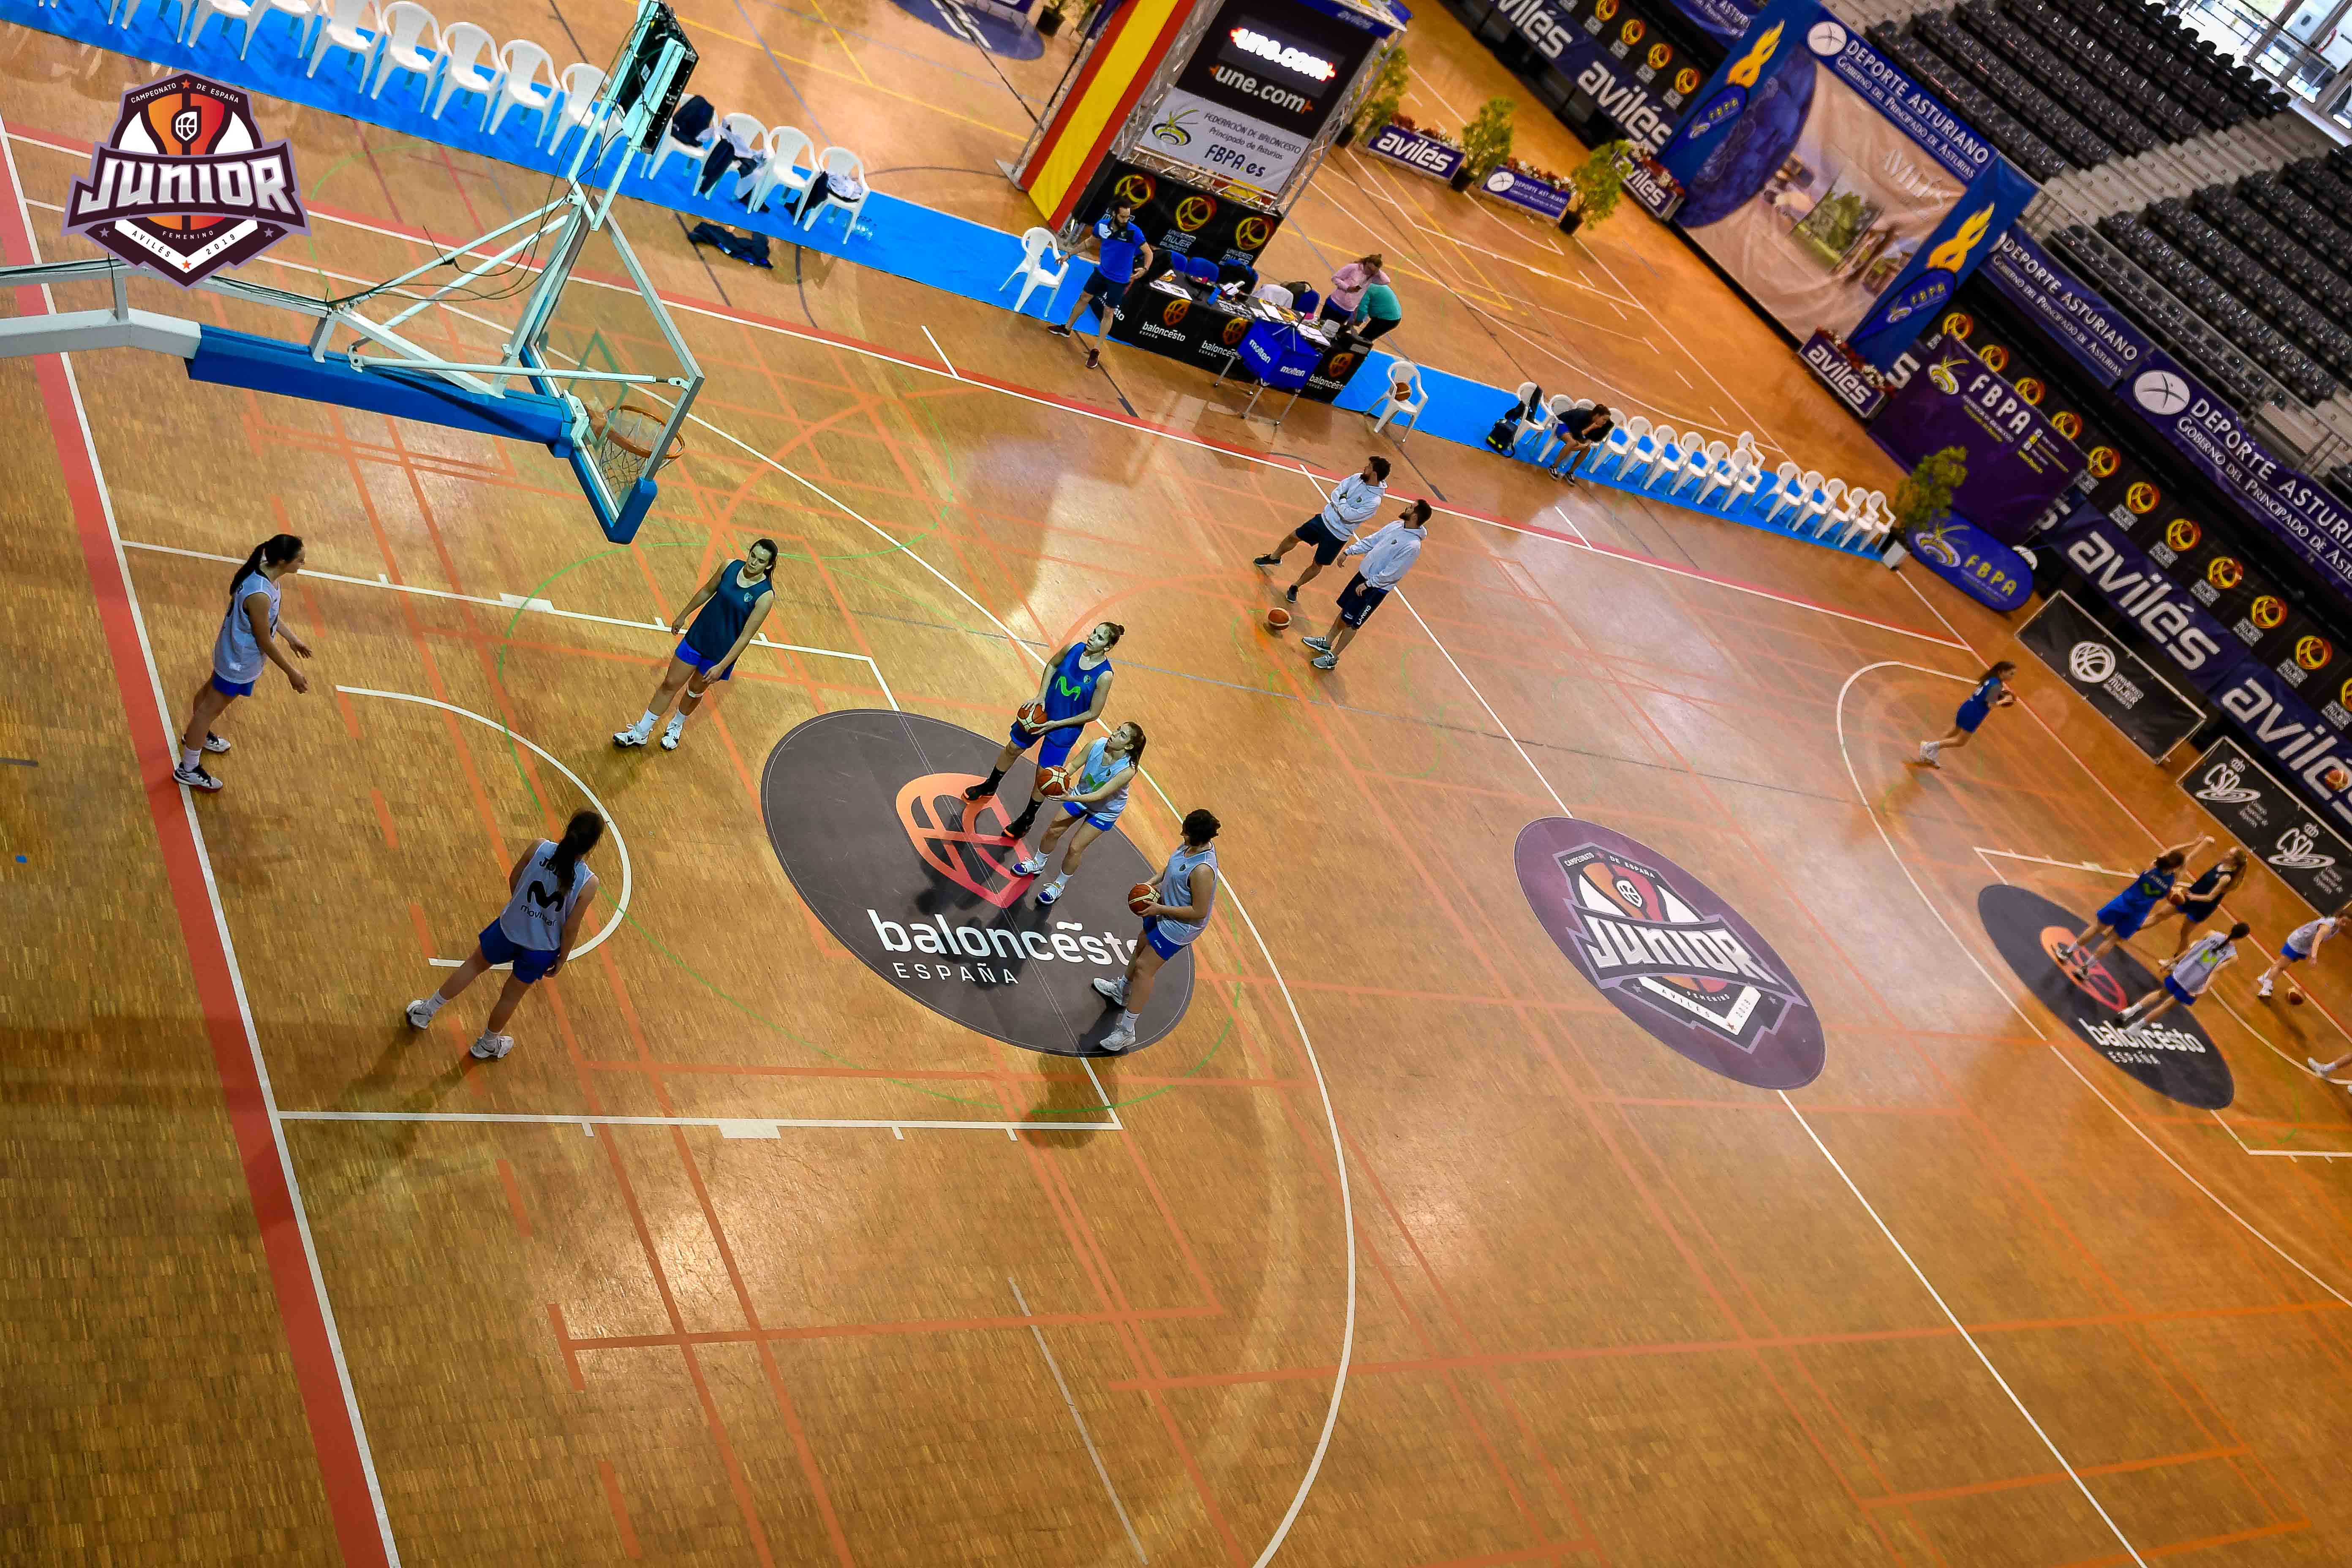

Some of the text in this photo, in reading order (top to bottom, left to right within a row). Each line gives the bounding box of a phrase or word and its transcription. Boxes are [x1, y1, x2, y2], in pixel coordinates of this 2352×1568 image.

[1215, 66, 1305, 112] une.com
[1846, 40, 1989, 163] DEPORTE ASTURIANO
[1209, 127, 1284, 160] Principado de Asturias
[1247, 129, 1258, 138] DE
[1258, 133, 1302, 154] BALONCESTO
[1377, 132, 1454, 173] avilés
[1204, 144, 1266, 177] FBPA.es
[1162, 234, 1192, 248] MUJER
[2001, 238, 2138, 361] DEPORTE ASTURIANO
[1249, 339, 1271, 364] molten
[1279, 365, 1305, 377] molten
[1968, 374, 2031, 435] FBPA
[2191, 397, 2277, 481] DEPORTE
[1965, 554, 2017, 596] FBPA
[1356, 605, 1372, 625] LI-NING
[2068, 530, 2221, 670] avilés
[1564, 851, 1595, 867] CAMPEONATO
[1609, 855, 1621, 864] DE
[520, 904, 558, 927] movistar
[893, 962, 1019, 984] ESPAÑA
